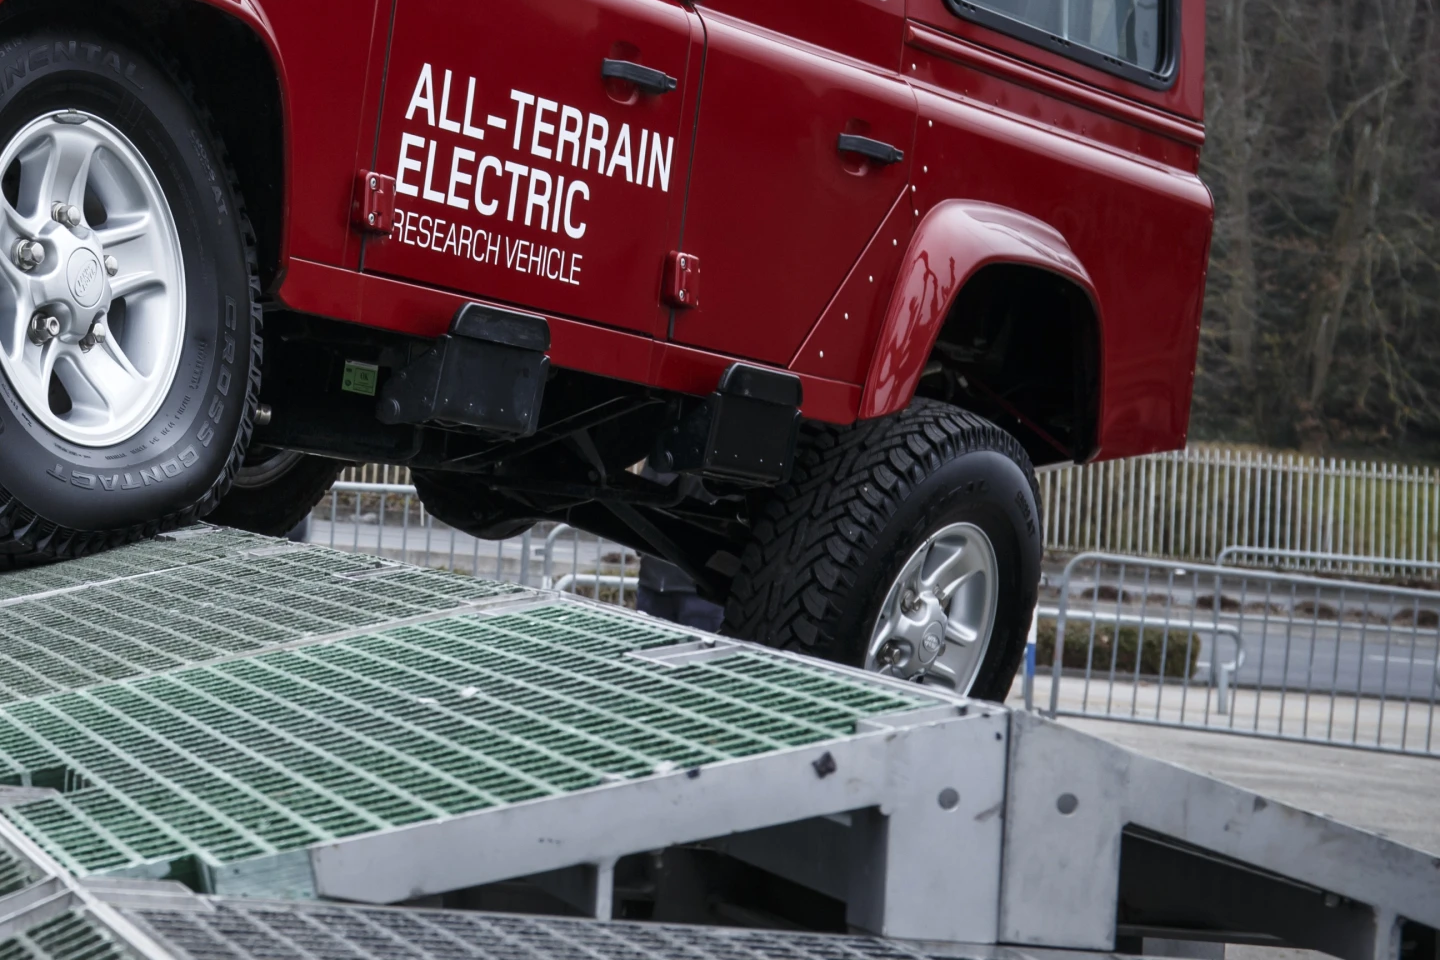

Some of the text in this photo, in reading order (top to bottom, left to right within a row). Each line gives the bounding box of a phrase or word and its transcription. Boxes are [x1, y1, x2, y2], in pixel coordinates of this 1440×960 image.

[405, 62, 674, 193] ALL-TERRAIN
[395, 132, 591, 239] ELECTRIC
[389, 208, 584, 286] RESEARCH VEHICLE
